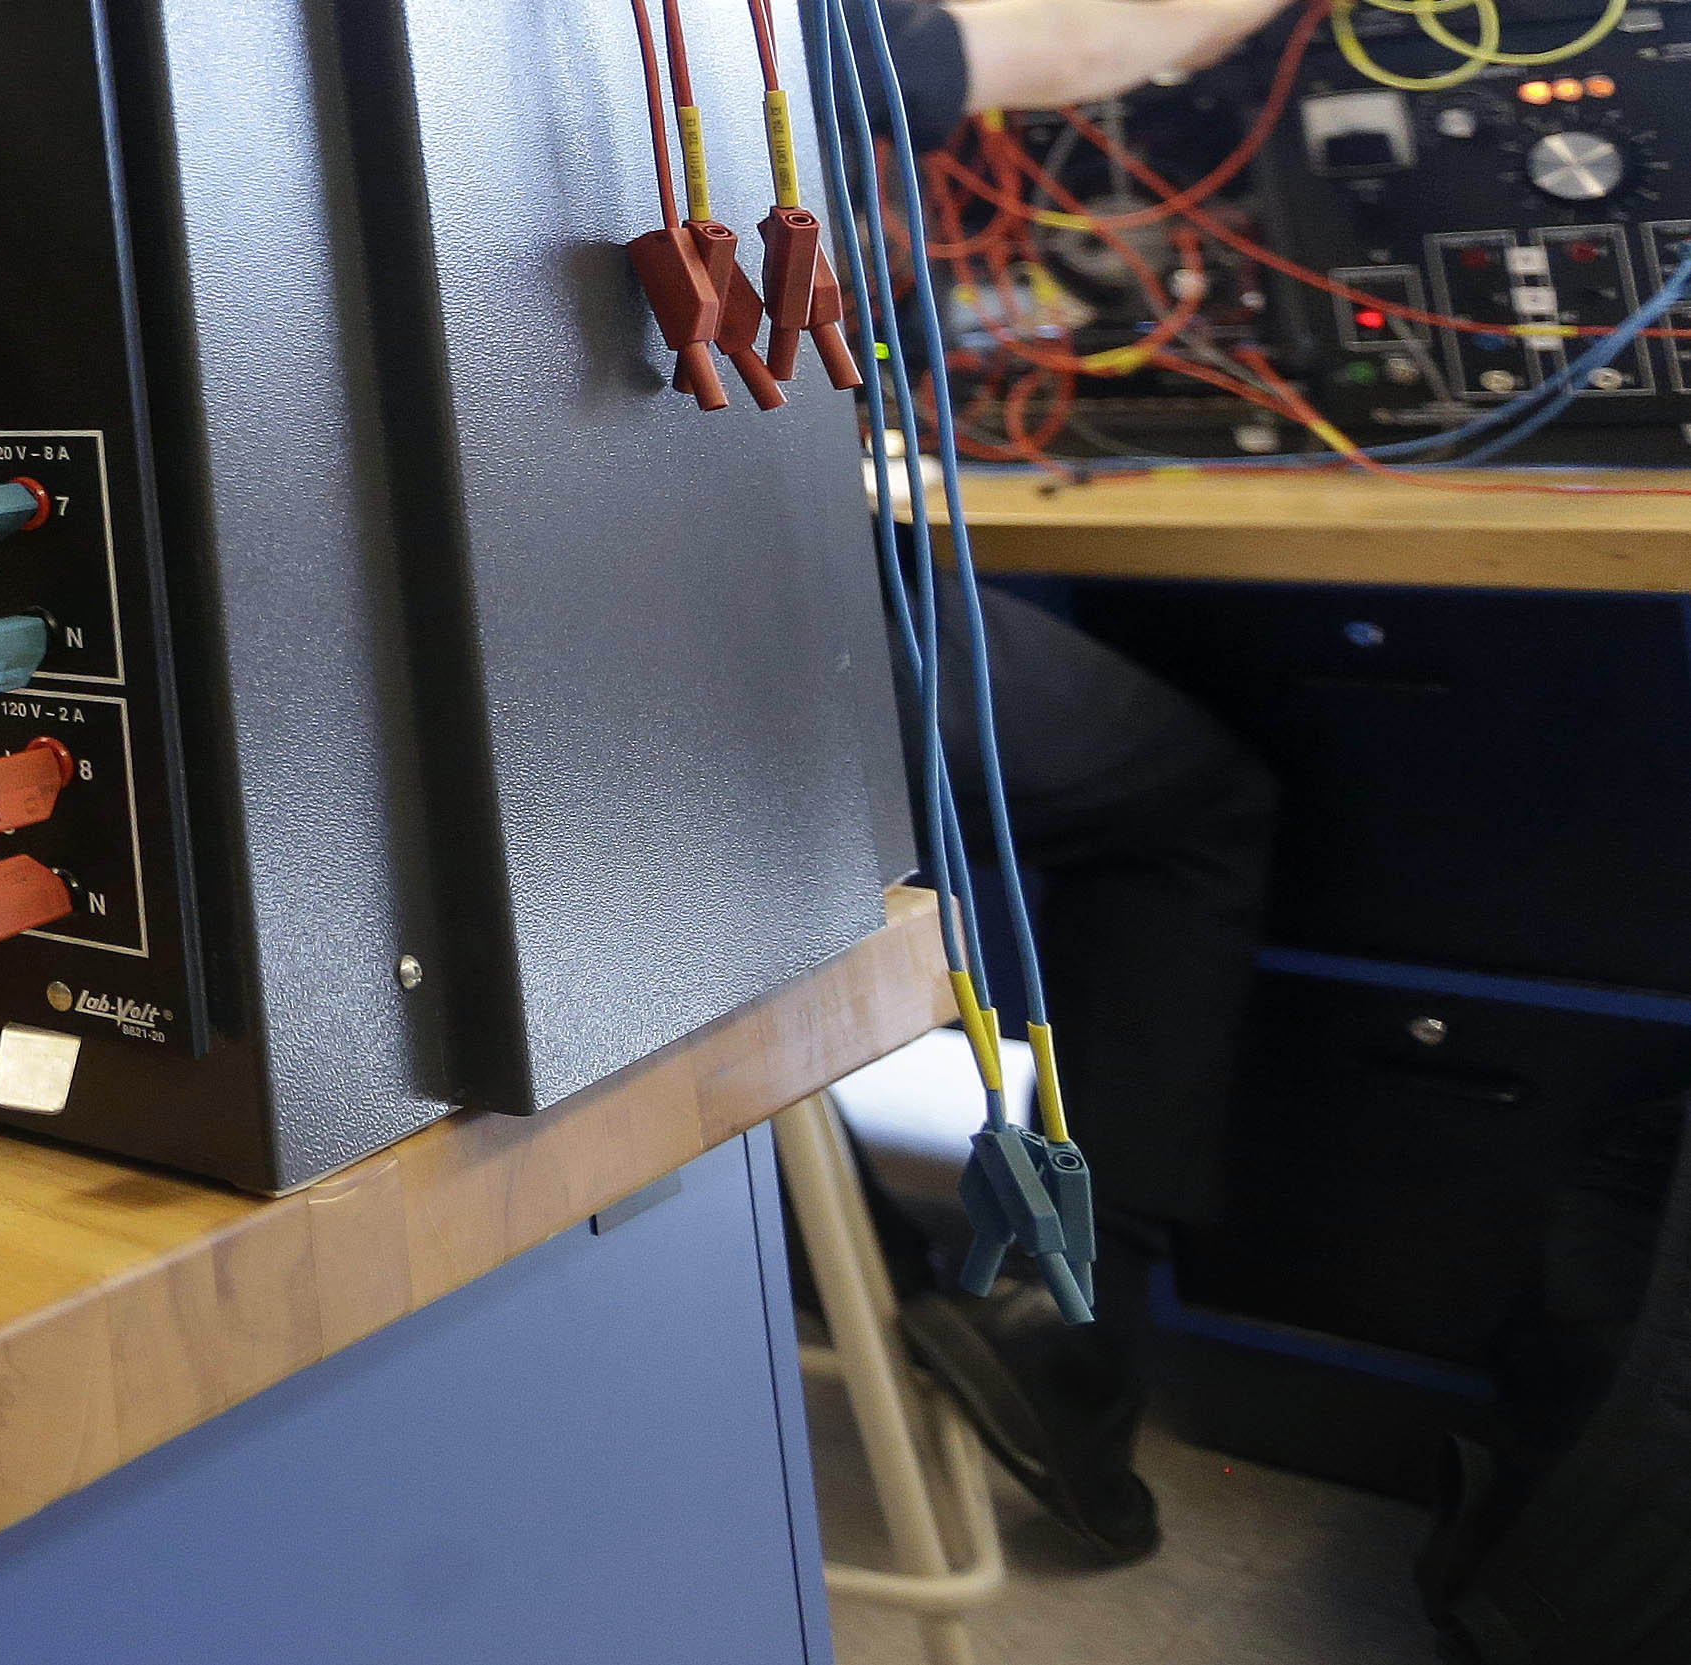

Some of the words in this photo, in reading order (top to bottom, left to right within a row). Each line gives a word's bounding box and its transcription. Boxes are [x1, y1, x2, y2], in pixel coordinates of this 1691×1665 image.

[15, 446, 26, 461] V
[44, 446, 54, 461] 8
[58, 446, 71, 461] A
[55, 496, 70, 516] 7
[66, 627, 83, 649] N
[1, 701, 27, 718] 120
[30, 703, 42, 719] V
[59, 707, 69, 722] 2
[73, 708, 85, 724] A
[79, 759, 93, 781] 8
[89, 892, 106, 916] N
